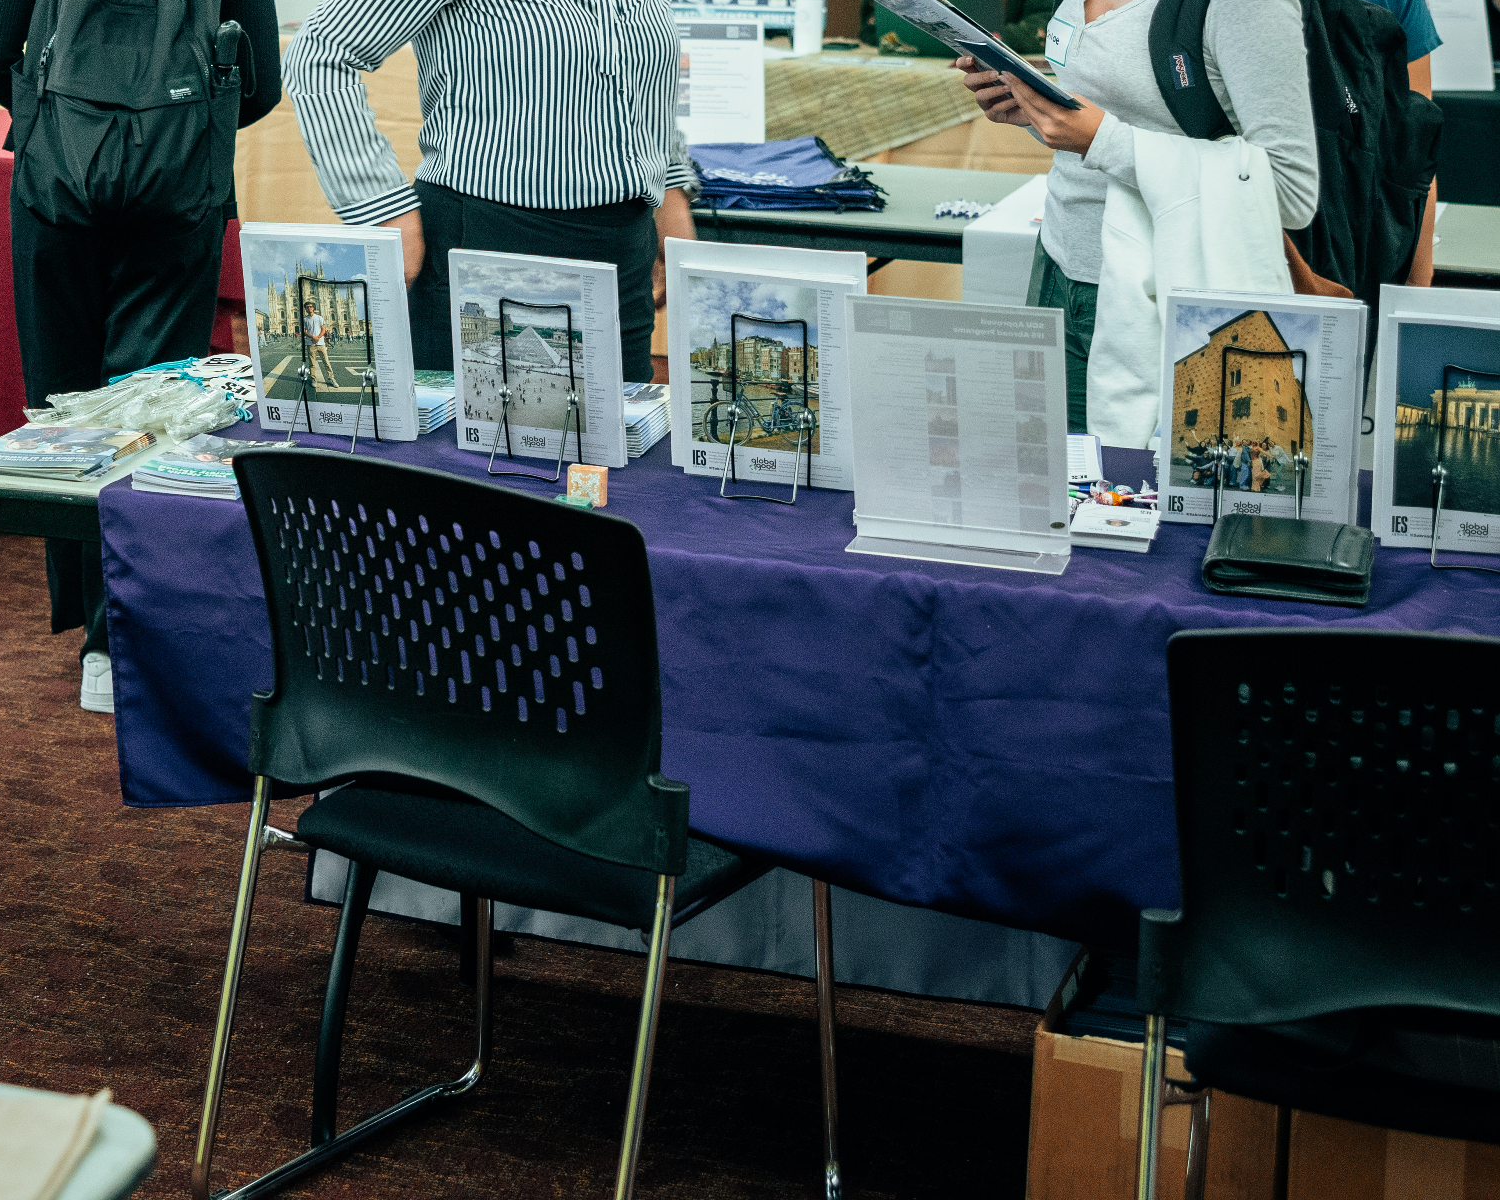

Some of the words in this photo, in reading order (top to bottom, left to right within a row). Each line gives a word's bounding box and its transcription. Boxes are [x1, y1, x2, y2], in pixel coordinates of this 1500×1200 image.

[267, 405, 280, 421] IES
[320, 411, 343, 421] global
[466, 426, 480, 442] IES
[522, 435, 546, 443] global
[526, 440, 546, 448] good
[693, 450, 707, 466] IES
[751, 457, 777, 466] global
[756, 463, 777, 471] good
[1168, 495, 1184, 512] IES
[1234, 501, 1261, 510] global
[1392, 515, 1408, 534] IES
[1460, 521, 1489, 531] global
[1464, 529, 1489, 537] good
